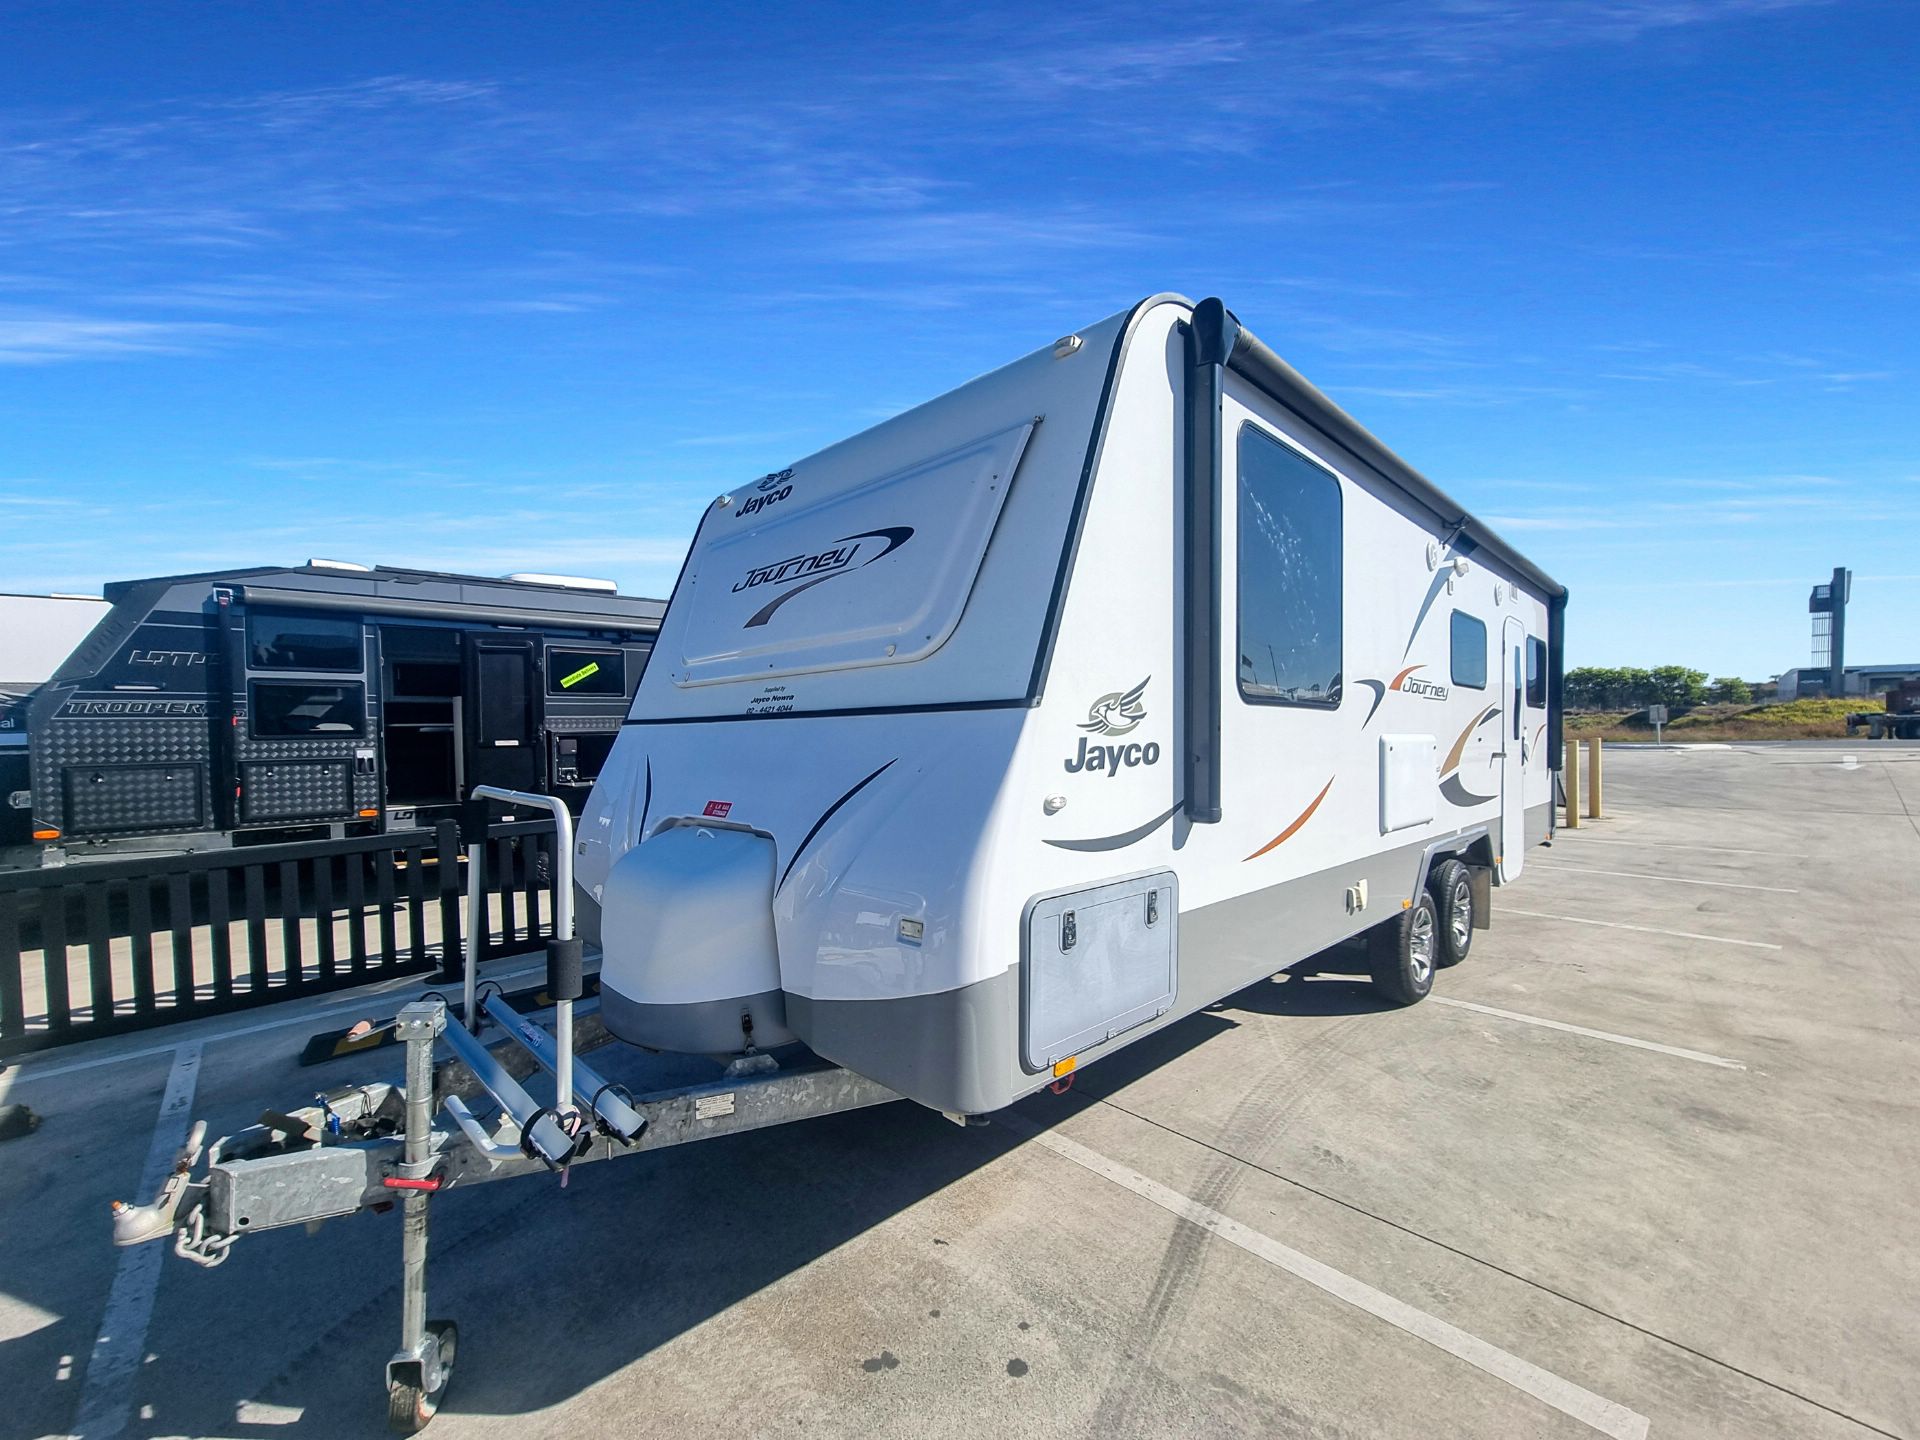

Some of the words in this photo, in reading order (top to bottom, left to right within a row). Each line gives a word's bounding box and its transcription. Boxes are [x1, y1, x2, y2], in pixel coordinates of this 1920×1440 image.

[735, 485, 793, 518] Jayco
[731, 543, 861, 593] Journey
[1402, 676, 1449, 701] Journey
[67, 701, 206, 715] TROOPER
[1064, 737, 1160, 777] Jayco
